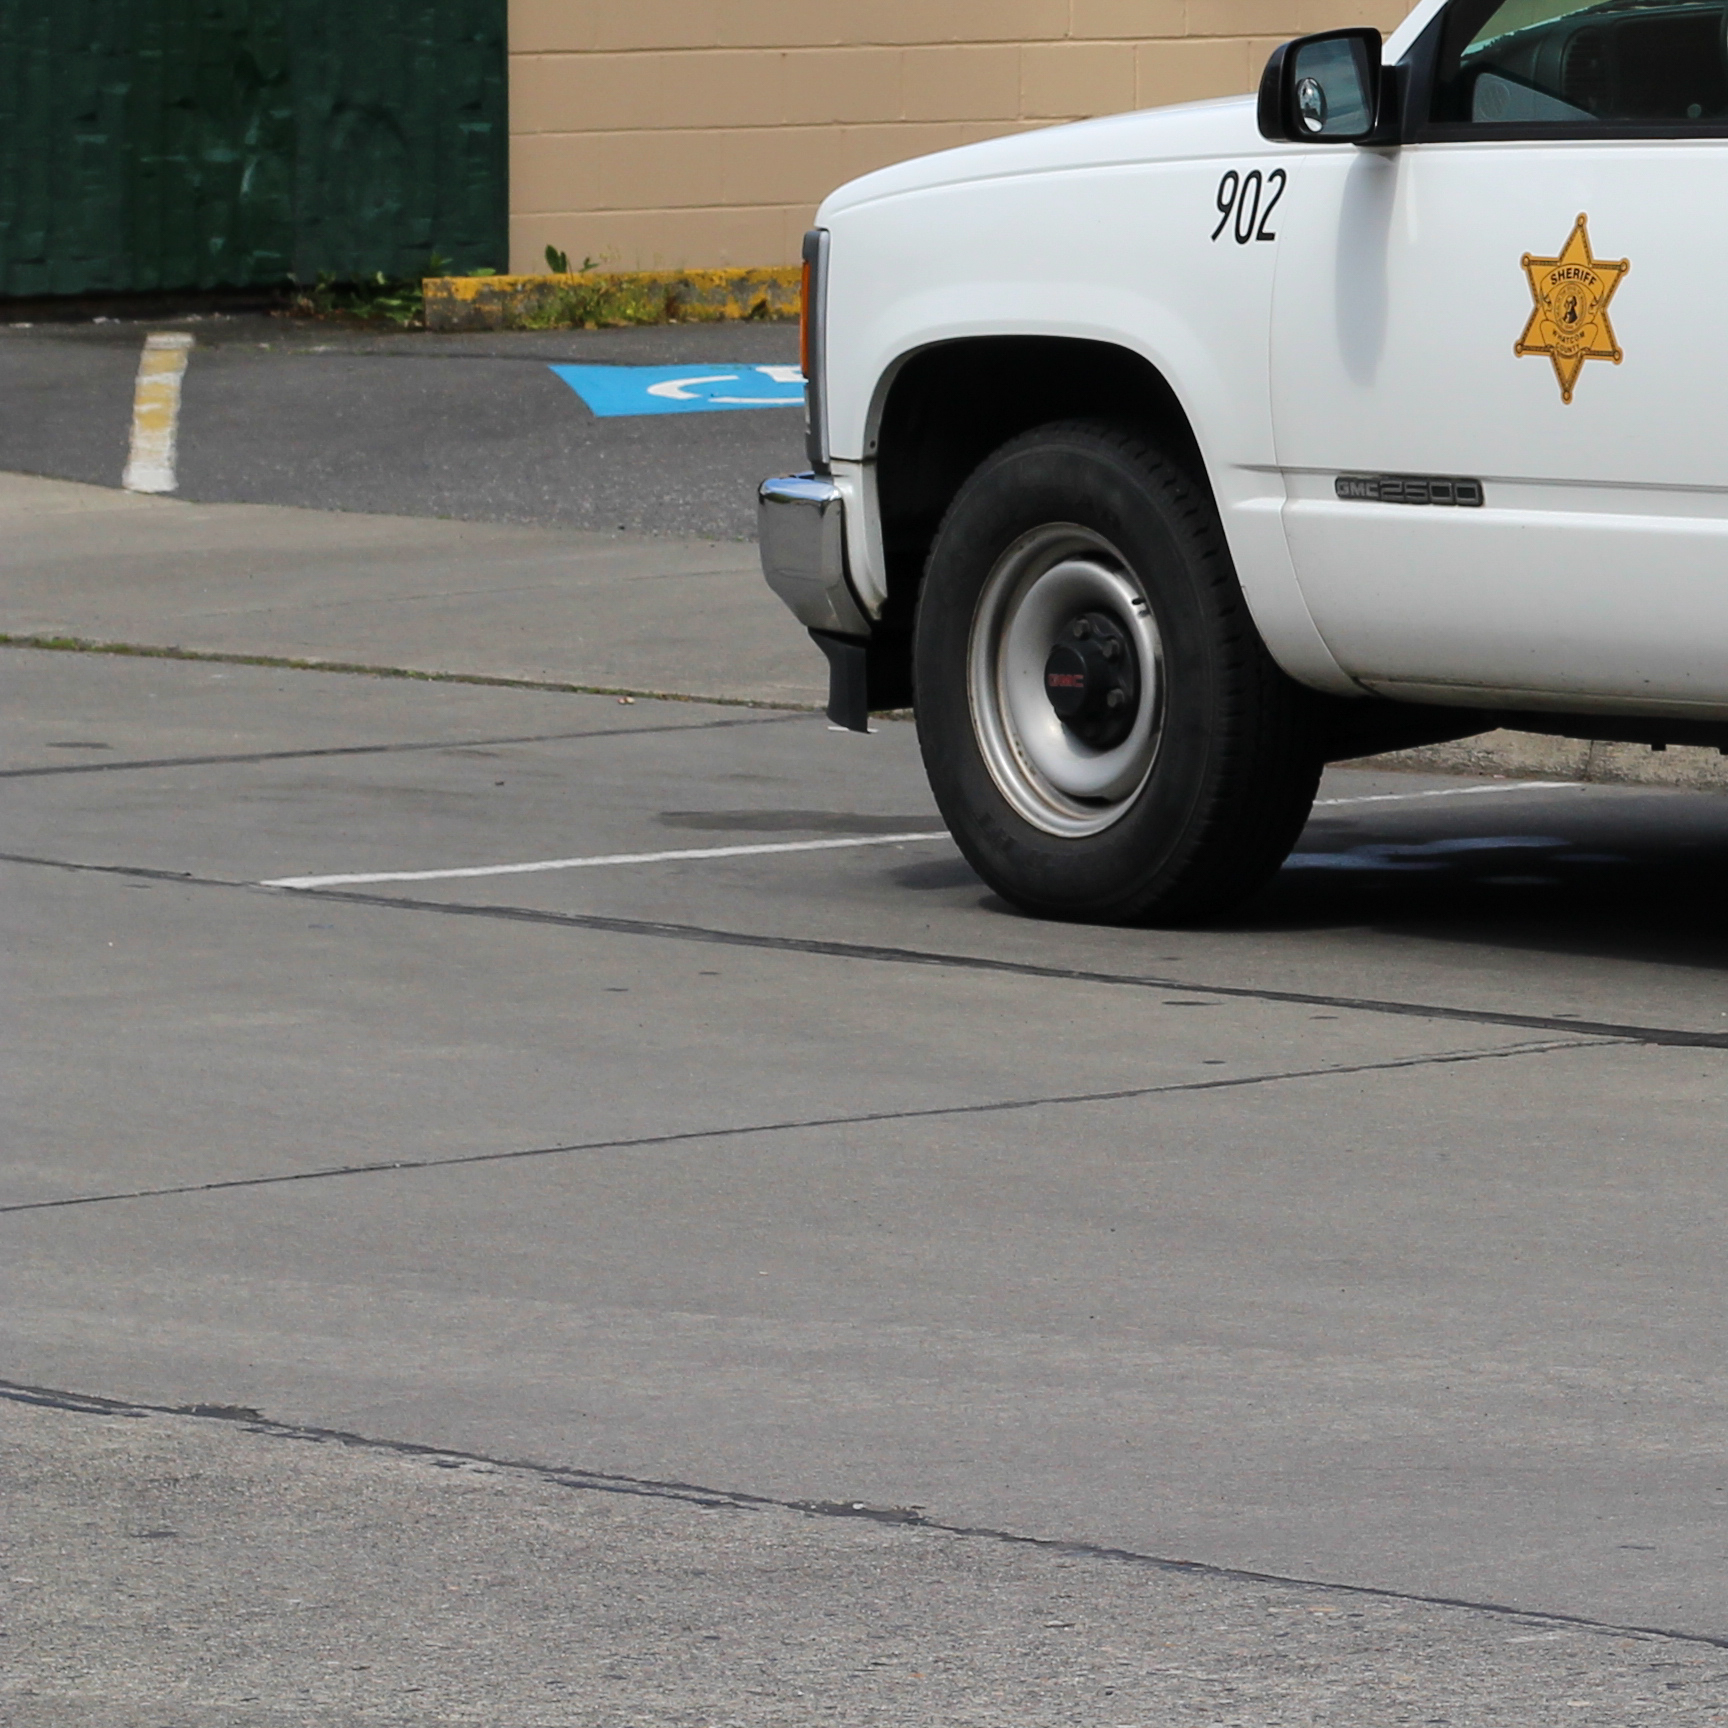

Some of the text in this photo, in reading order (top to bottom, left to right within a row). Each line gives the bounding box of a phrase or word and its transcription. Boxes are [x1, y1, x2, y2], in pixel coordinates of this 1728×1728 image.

[1211, 167, 1287, 245] 902
[1551, 268, 1597, 285] SHERIFF
[1553, 328, 1585, 344] WHATCOM
[1379, 479, 1482, 506] 2500
